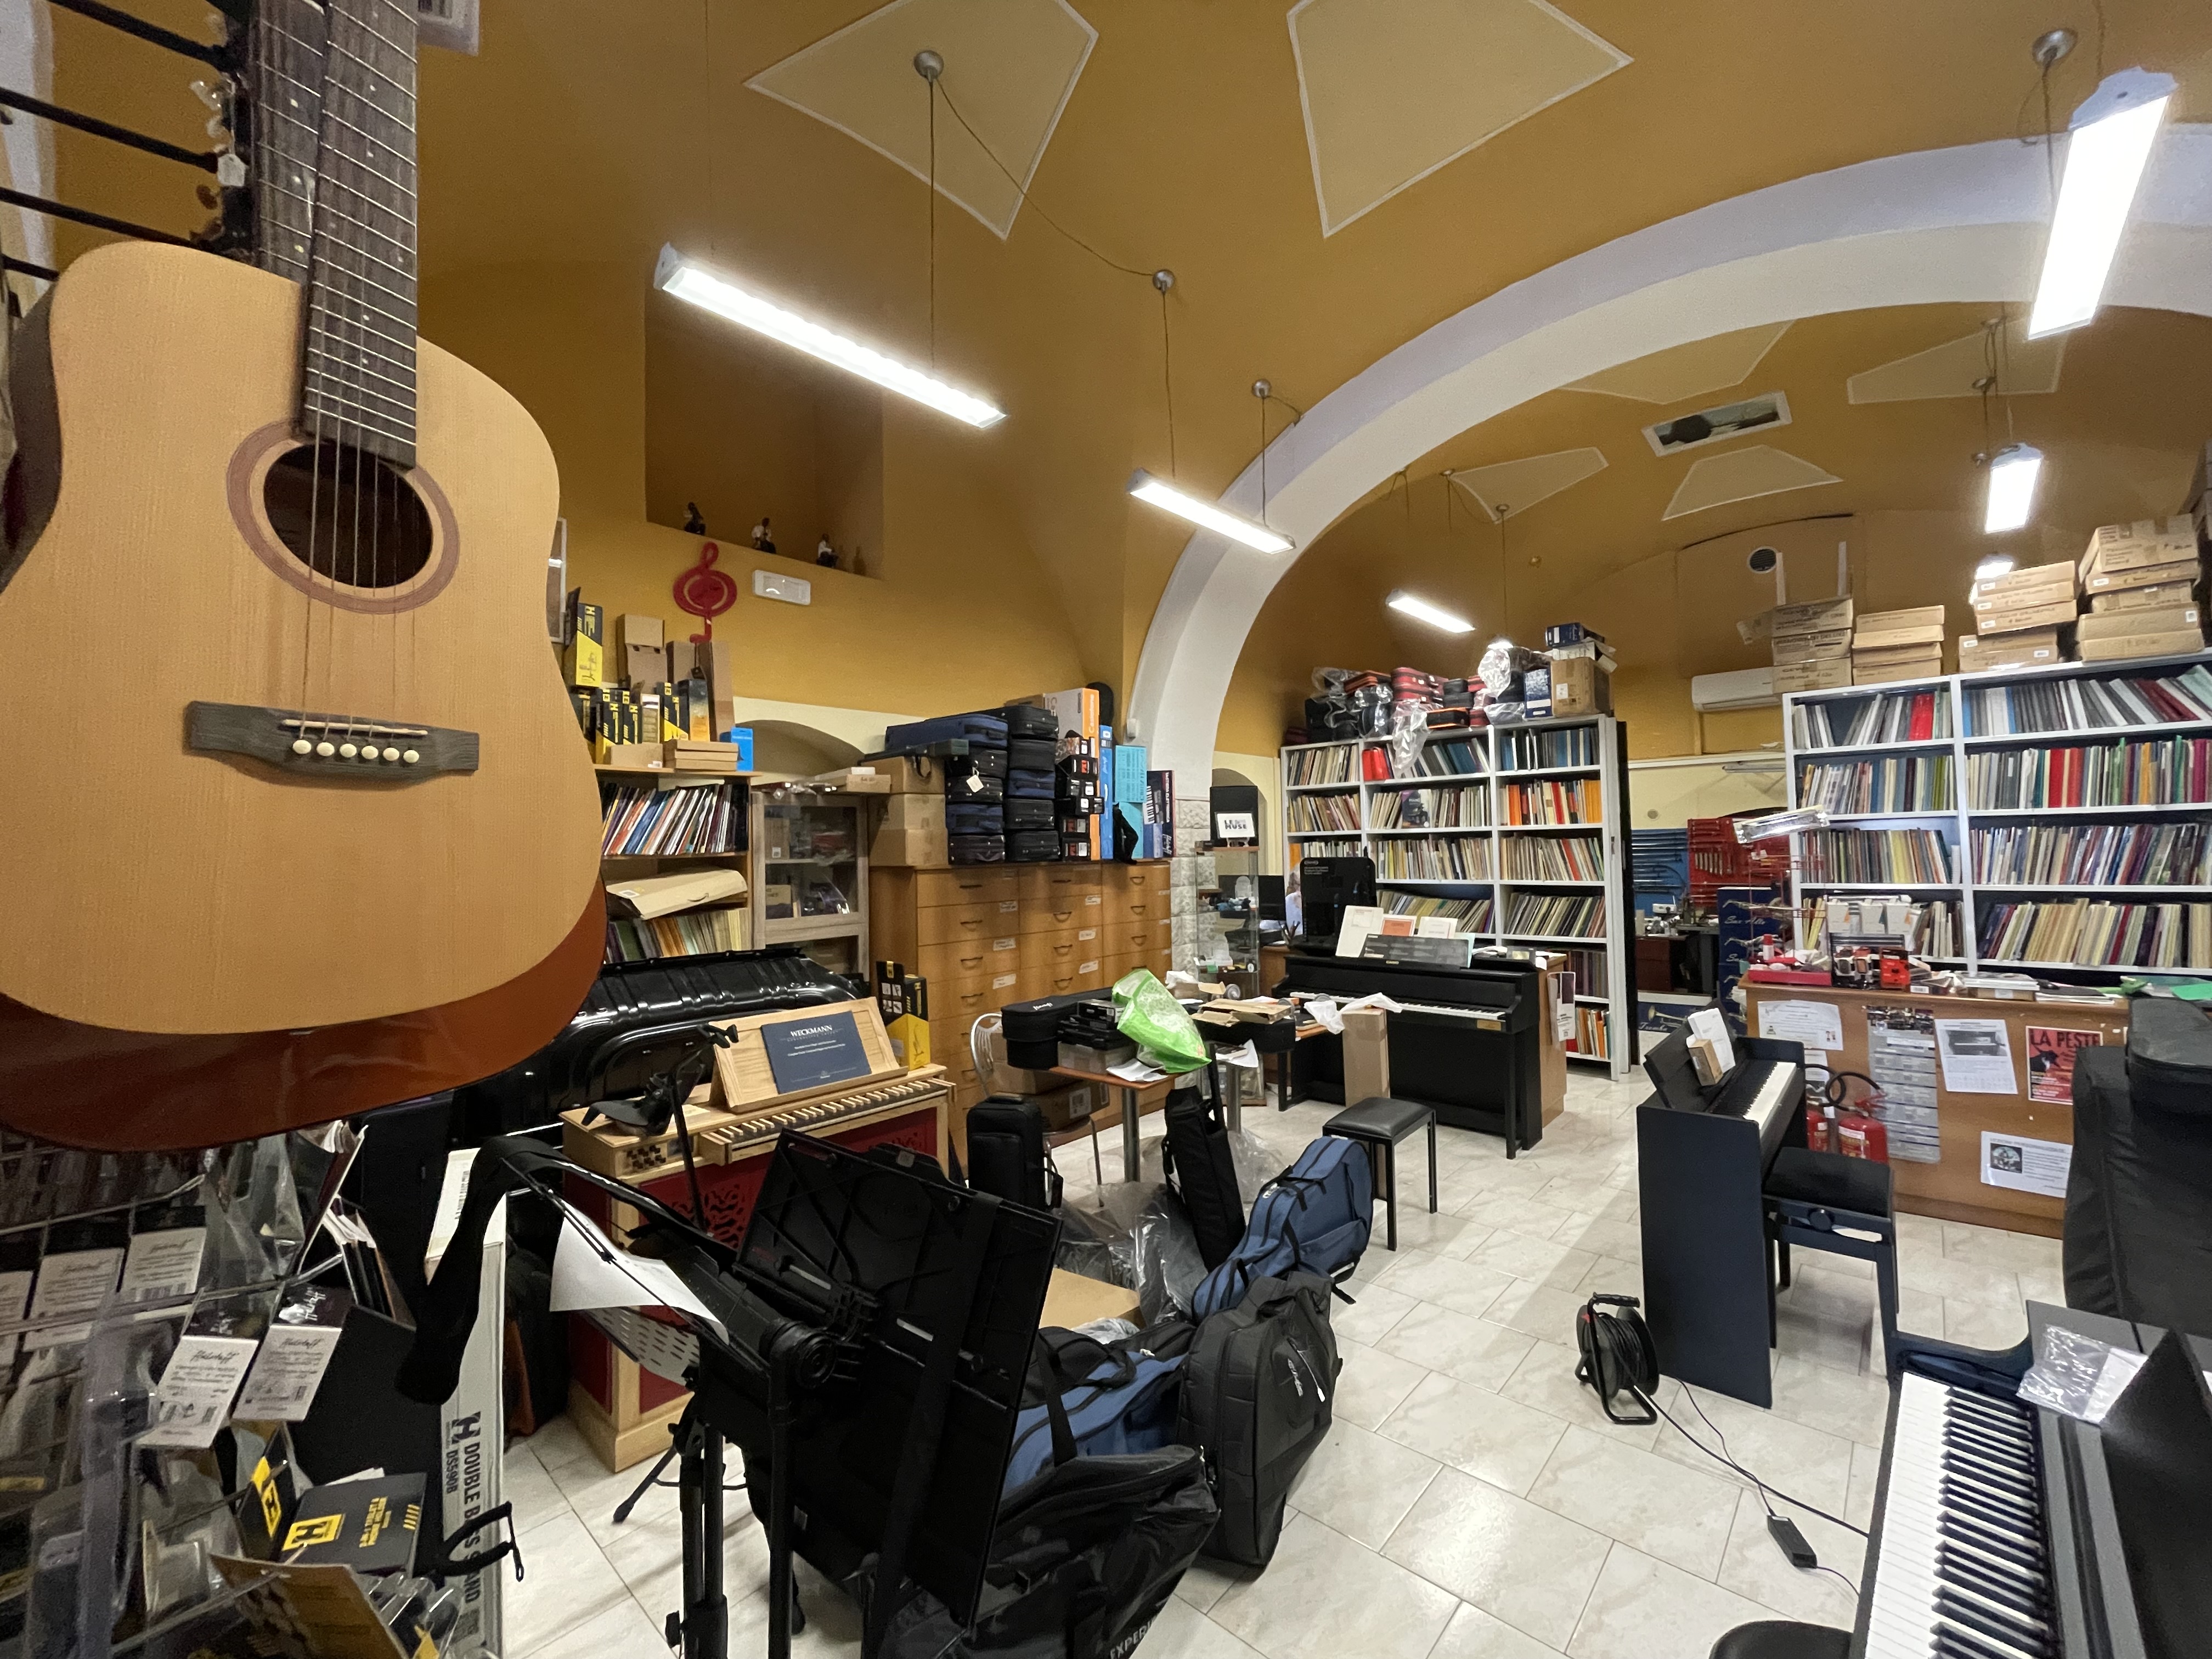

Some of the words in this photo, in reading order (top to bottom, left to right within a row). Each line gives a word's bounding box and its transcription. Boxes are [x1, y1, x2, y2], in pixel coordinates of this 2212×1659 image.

[790, 1024, 833, 1037] WECKMANN
[2030, 1030, 2051, 1047] LA
[446, 1449, 459, 1494] DS590B
[464, 1441, 481, 1505] DOUBLE
